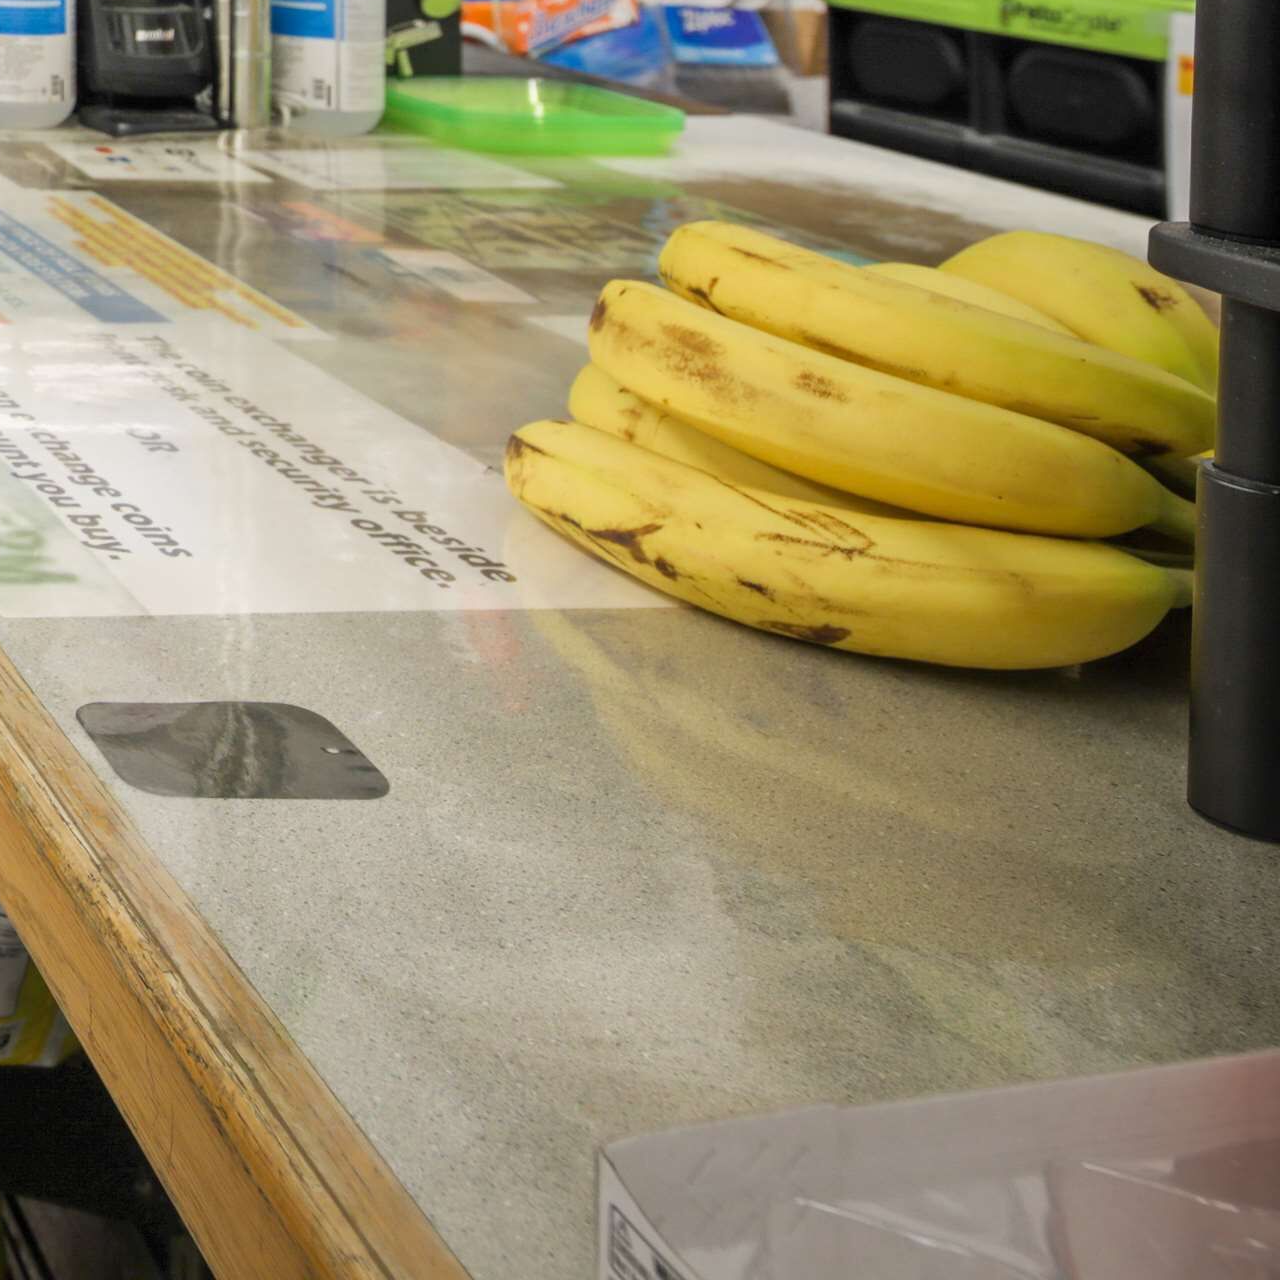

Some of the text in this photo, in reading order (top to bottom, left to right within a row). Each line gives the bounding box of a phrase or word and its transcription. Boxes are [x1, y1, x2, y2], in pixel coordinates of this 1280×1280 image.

[10, 470, 82, 510] you
[67, 513, 134, 560] buy.
[111, 501, 193, 559] coins
[175, 361, 230, 393] coin
[224, 394, 371, 485] exchanger
[363, 481, 401, 505] is
[393, 509, 518, 584] beside
[189, 406, 251, 437] and
[240, 437, 361, 512] security
[350, 518, 457, 589] office.
